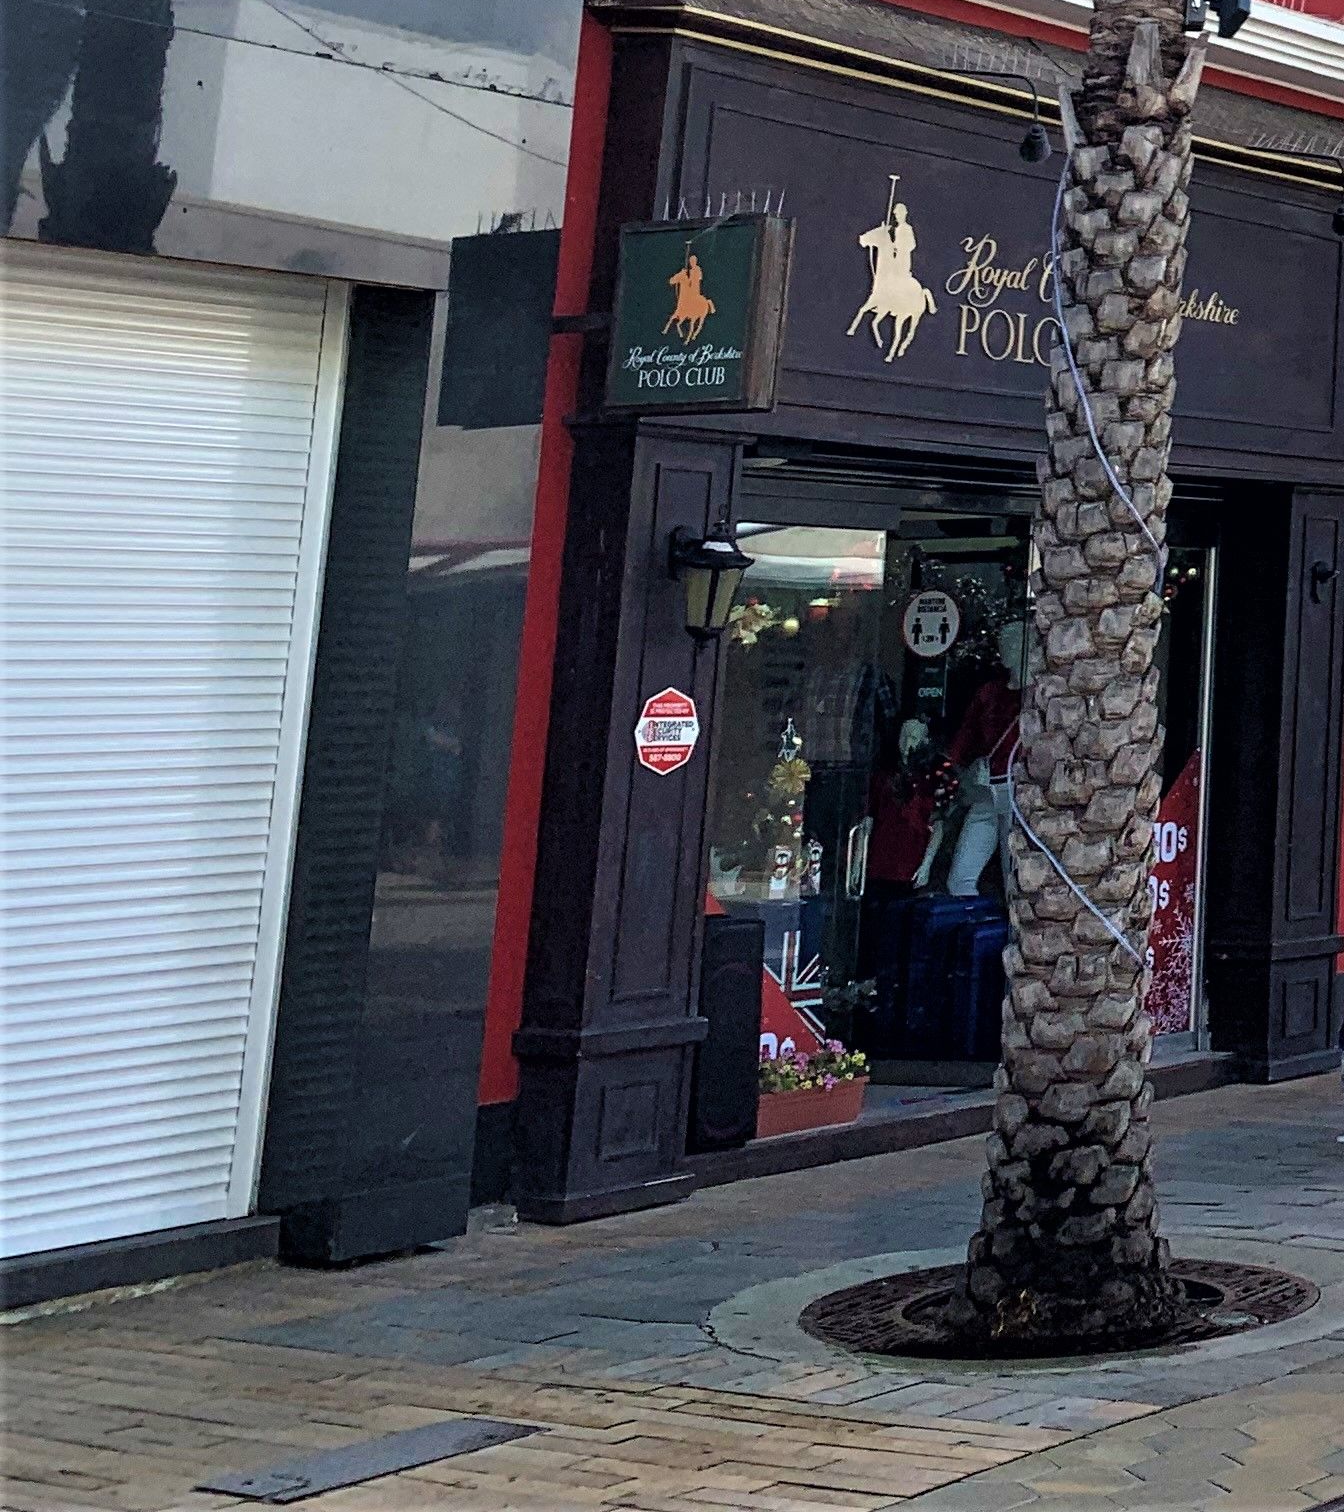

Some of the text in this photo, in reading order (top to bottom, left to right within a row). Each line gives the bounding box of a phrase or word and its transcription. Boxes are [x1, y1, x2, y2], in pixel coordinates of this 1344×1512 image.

[945, 233, 1038, 307] Royal
[1177, 288, 1239, 326] rkshire
[623, 347, 656, 370] Royal
[656, 345, 687, 369] County
[688, 348, 700, 362] of
[638, 367, 725, 387] POLO CLUB
[918, 687, 943, 698] OPEN
